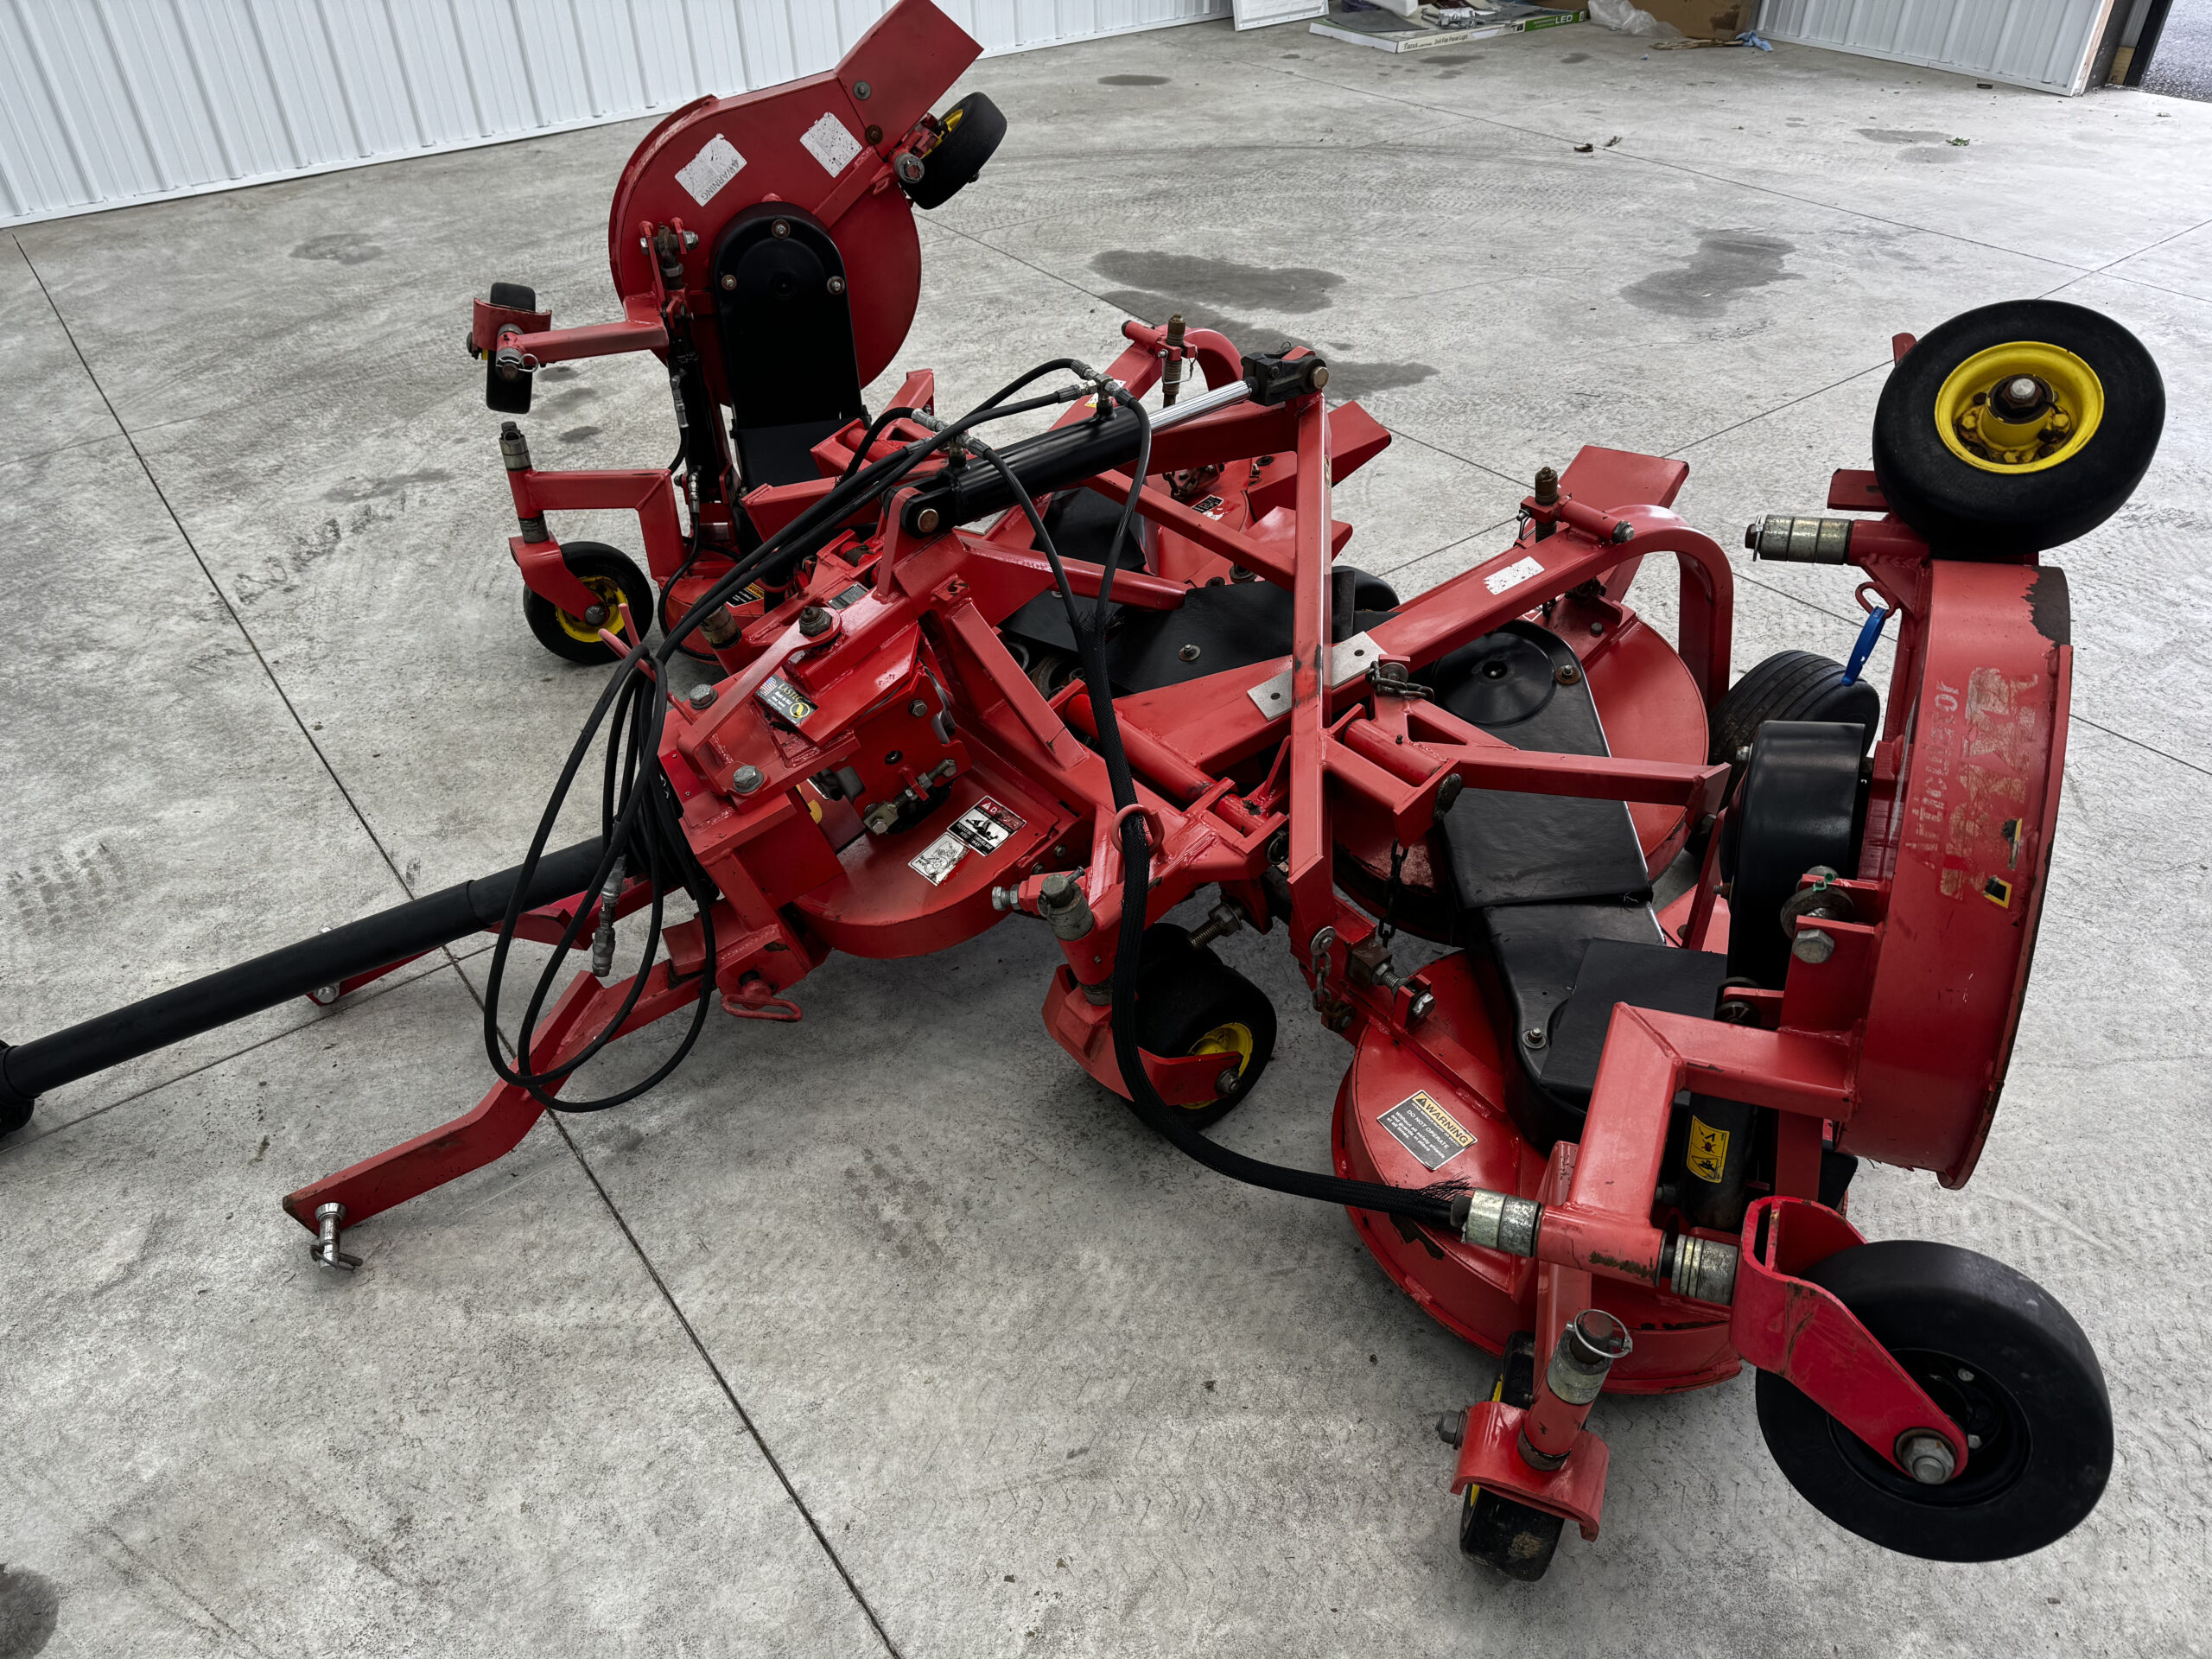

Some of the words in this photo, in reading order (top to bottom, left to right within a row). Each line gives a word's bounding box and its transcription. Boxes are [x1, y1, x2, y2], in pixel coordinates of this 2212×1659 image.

[1555, 14, 1573, 24] LED
[701, 166, 735, 200] WARNING
[779, 683, 804, 702] LASTEC
[956, 823, 974, 836] ROTATIN
[1390, 1115, 1401, 1123] and
[1399, 1122, 1414, 1136] guards
[1417, 1139, 1431, 1152] place
[1407, 1109, 1416, 1118] DO
[1414, 1116, 1427, 1128] NOT
[1425, 1126, 1450, 1149] OPERATE
[1426, 1103, 1469, 1144] WARNING
[1416, 1131, 1430, 1145] safety
[1430, 1143, 1446, 1159] shields
